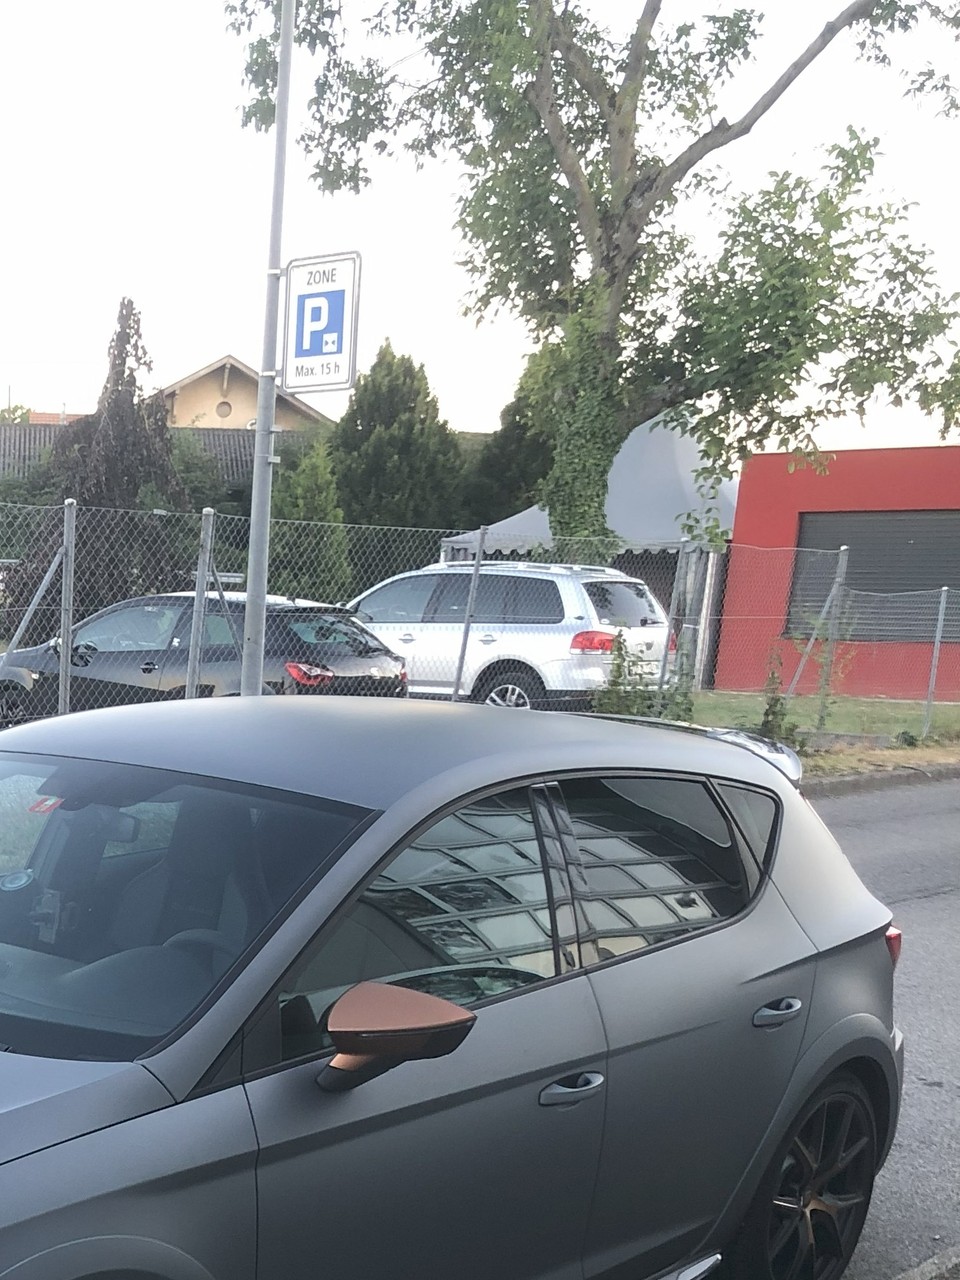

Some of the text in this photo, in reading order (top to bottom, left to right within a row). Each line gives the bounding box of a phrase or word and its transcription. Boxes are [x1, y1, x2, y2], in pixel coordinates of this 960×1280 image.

[307, 268, 337, 286] ZONE
[302, 296, 329, 351] P
[295, 361, 340, 378] Max. 15 h
